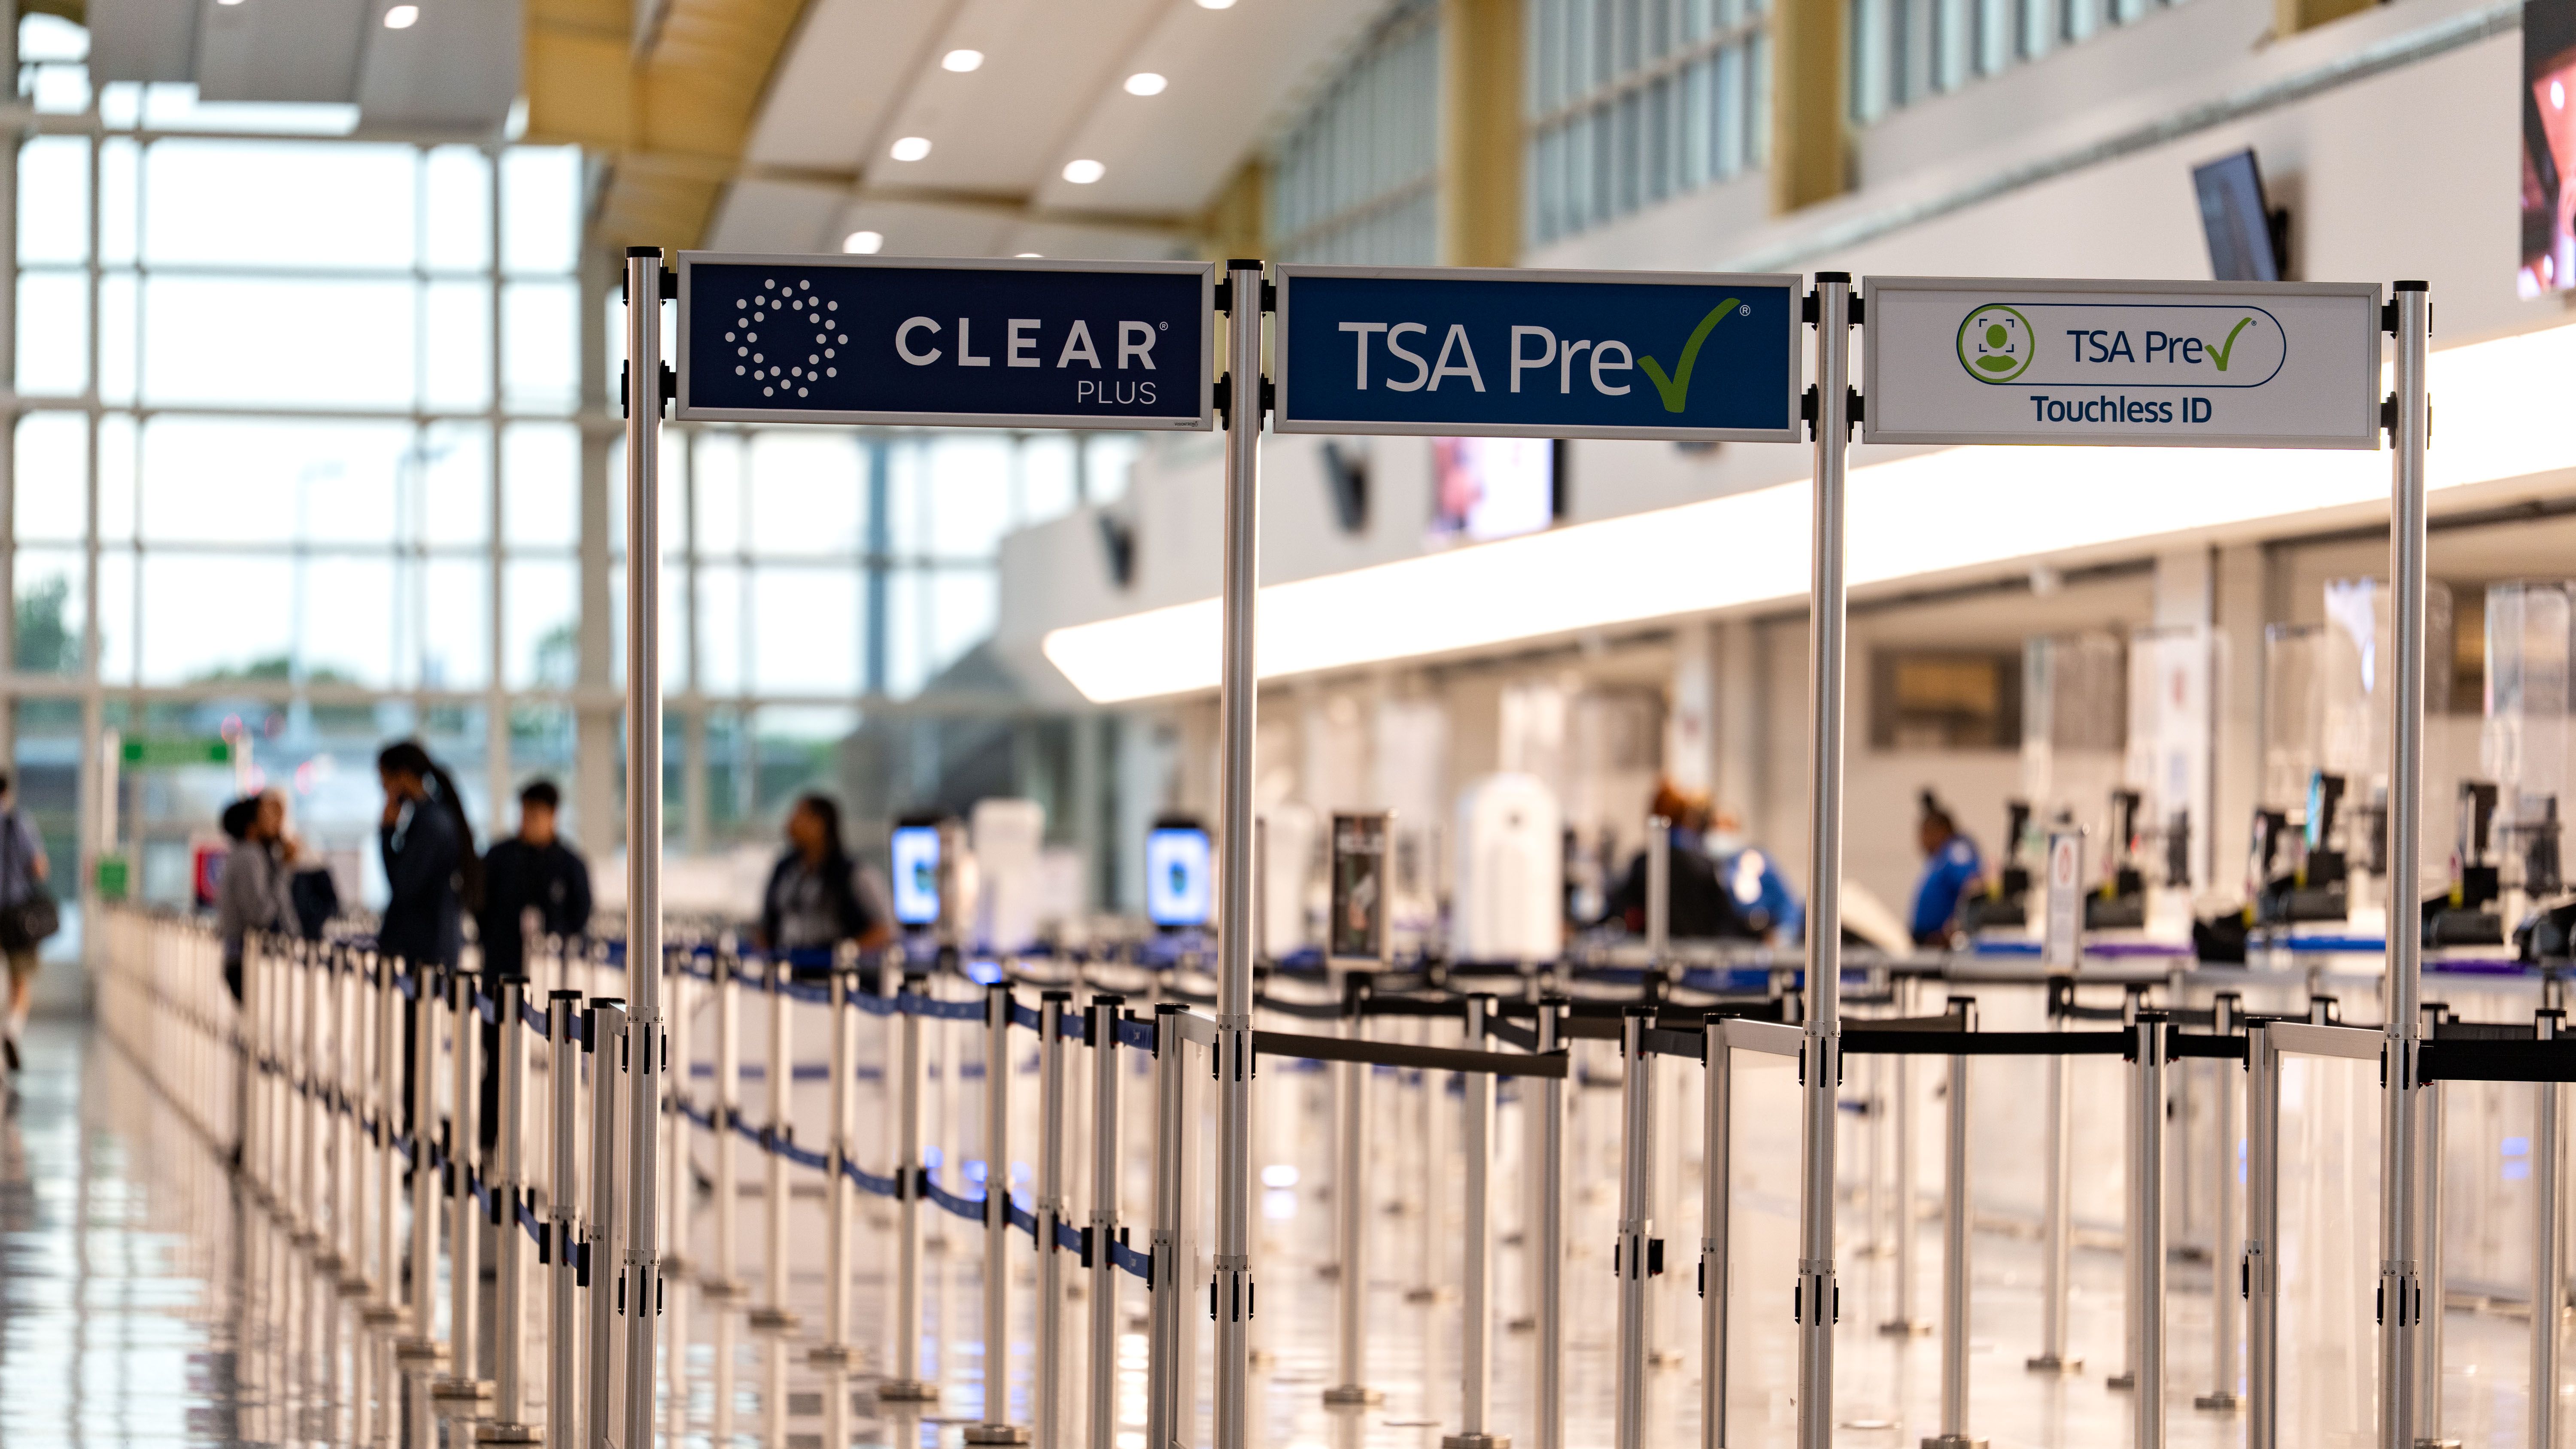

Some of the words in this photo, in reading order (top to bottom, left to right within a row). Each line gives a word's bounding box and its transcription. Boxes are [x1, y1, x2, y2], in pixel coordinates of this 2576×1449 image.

[1338, 322, 1486, 392] TSA
[2066, 330, 2135, 363] TSA
[1078, 380, 1156, 405] PLUS
[2030, 395, 2173, 423] Touchless
[2183, 397, 2212, 423] ID
